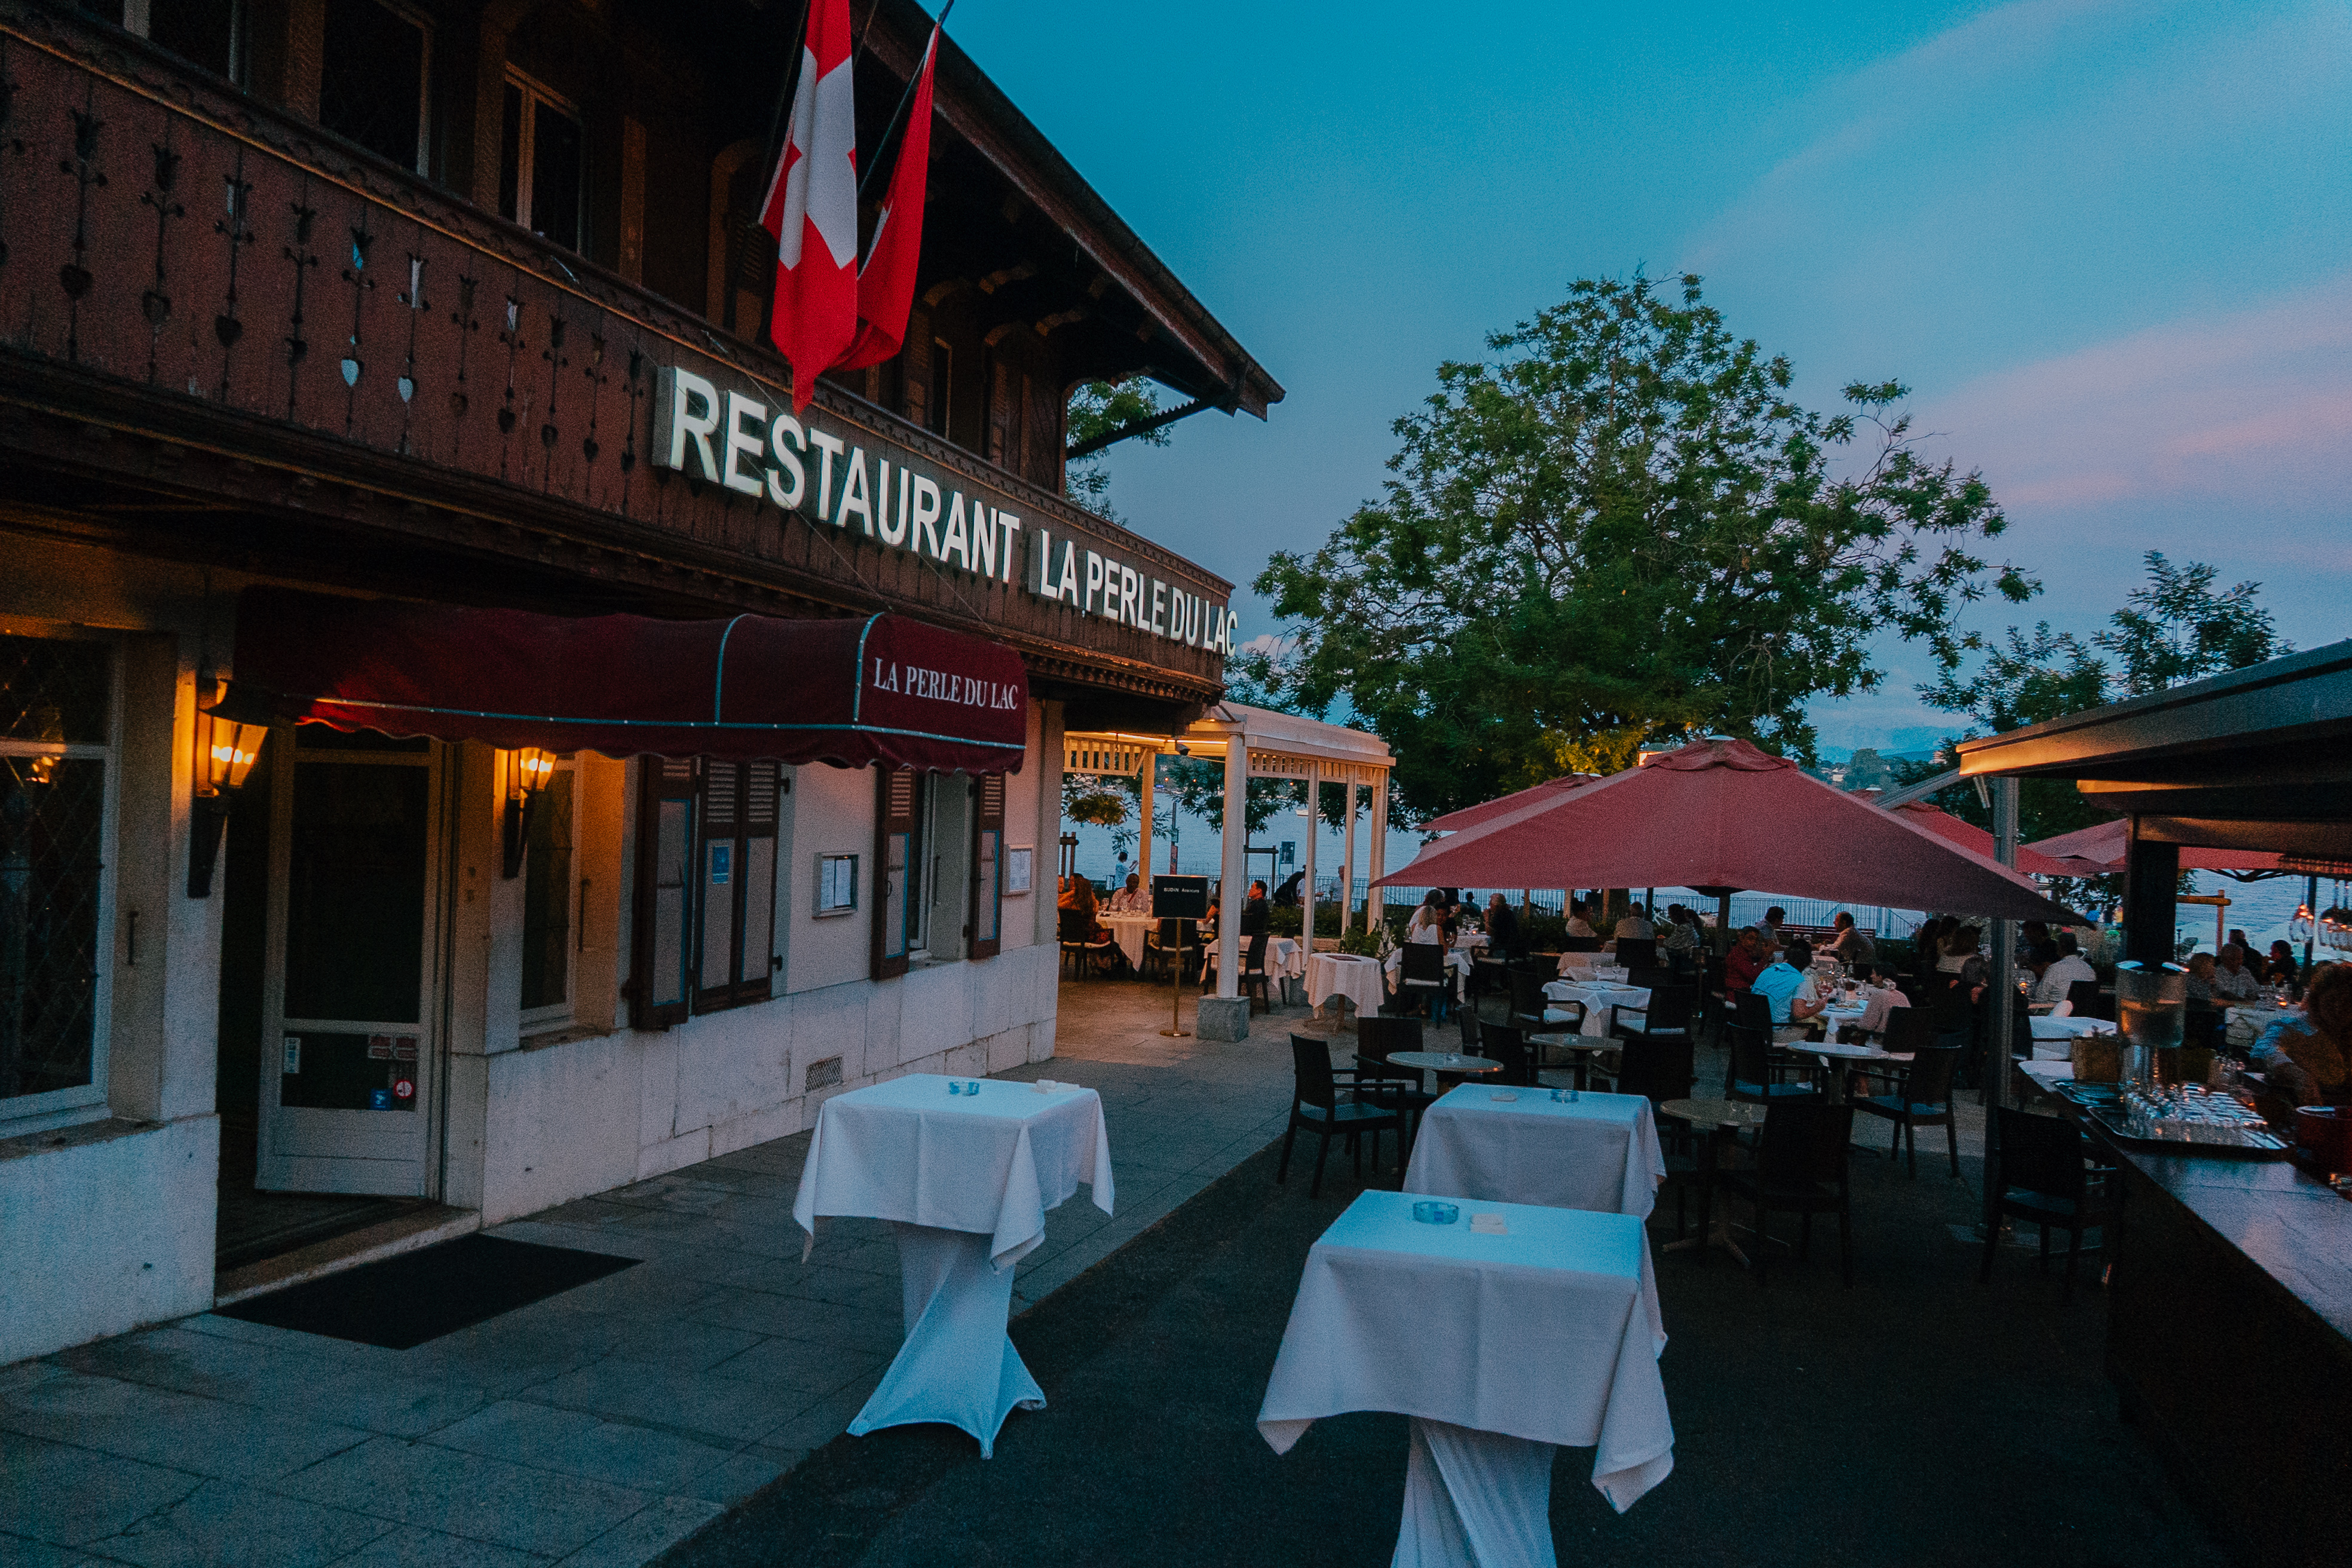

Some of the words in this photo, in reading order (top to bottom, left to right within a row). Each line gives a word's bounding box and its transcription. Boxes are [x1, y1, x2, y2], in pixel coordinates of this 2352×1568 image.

[670, 366, 1020, 583] RESTAURANT
[1040, 529, 1079, 607] LA
[1086, 550, 1166, 636] PERLE
[1170, 587, 1199, 646] DU
[1203, 600, 1238, 657] LAC
[873, 657, 899, 693] LA
[905, 665, 961, 703] PERLE
[963, 677, 988, 707] DU
[990, 682, 1018, 710] LAC
